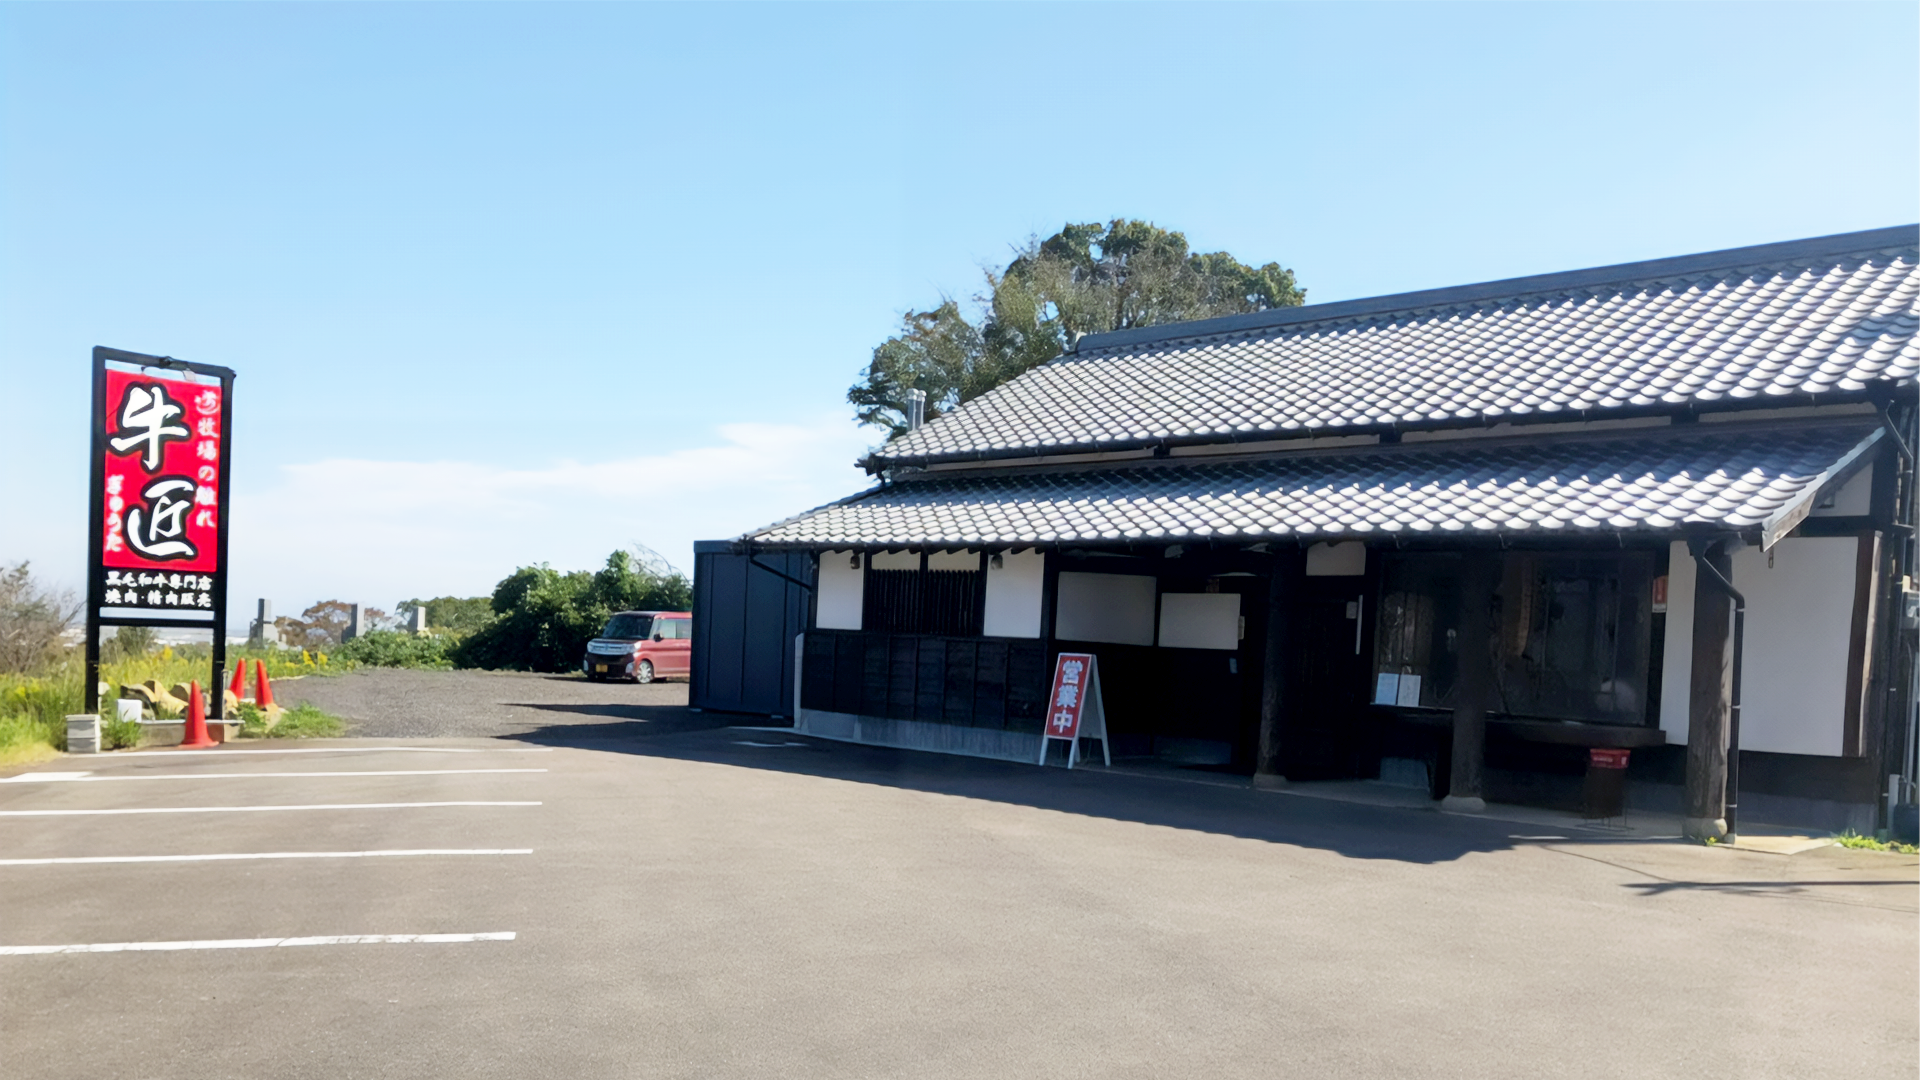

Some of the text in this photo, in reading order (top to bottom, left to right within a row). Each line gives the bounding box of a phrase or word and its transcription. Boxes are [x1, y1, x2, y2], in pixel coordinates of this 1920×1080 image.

[109, 385, 195, 557] 牛匠
[1052, 660, 1083, 734] 営業中
